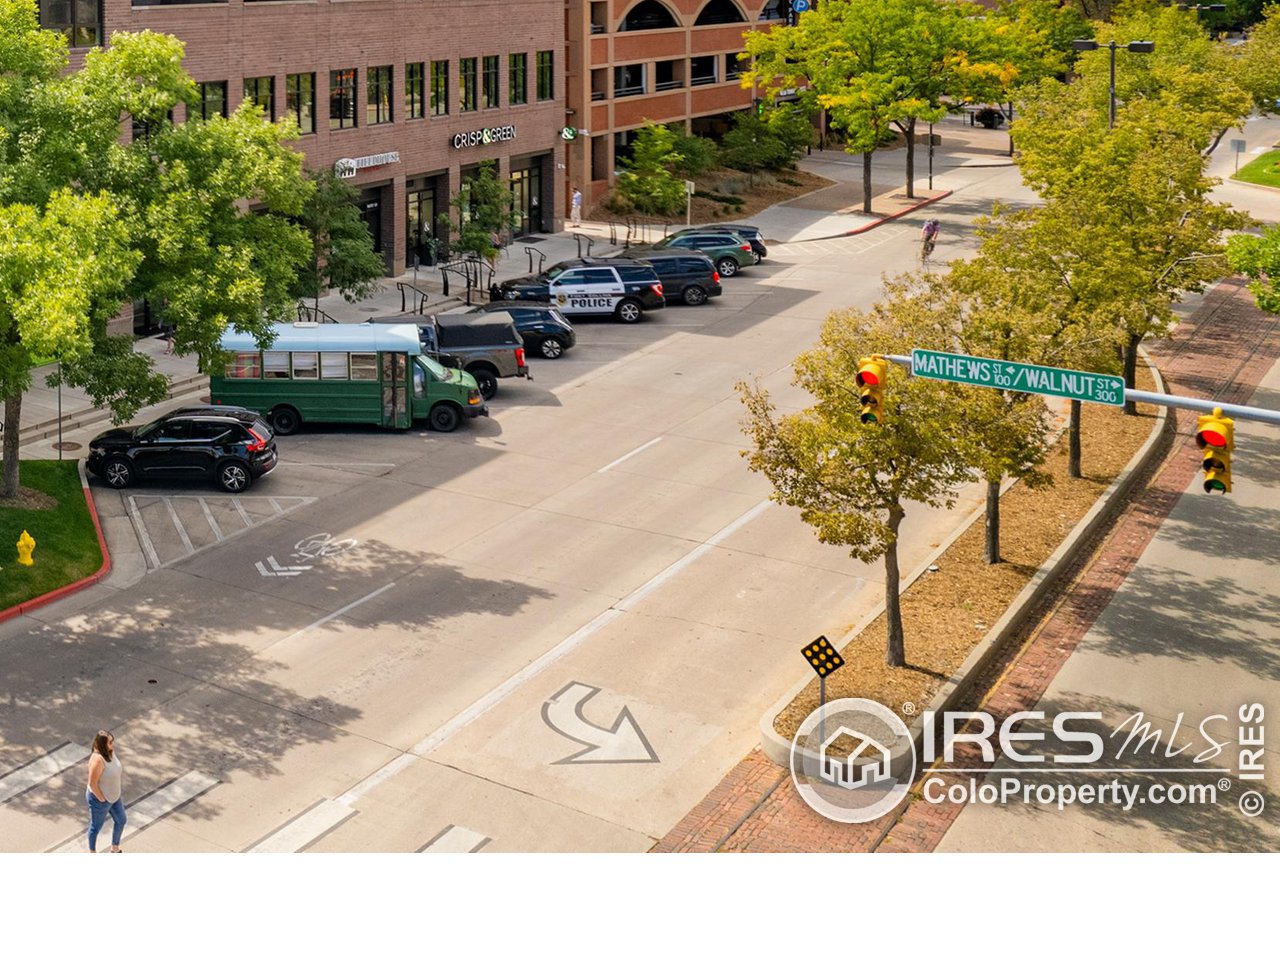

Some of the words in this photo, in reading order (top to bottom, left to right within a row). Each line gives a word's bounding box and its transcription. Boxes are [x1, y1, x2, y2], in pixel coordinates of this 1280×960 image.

[571, 299, 613, 308] POLICE
[915, 353, 991, 381] MATHEWS
[992, 363, 1002, 375] ST
[1096, 378, 1110, 390] ST
[994, 374, 1011, 386] 100
[1095, 390, 1117, 402] 300
